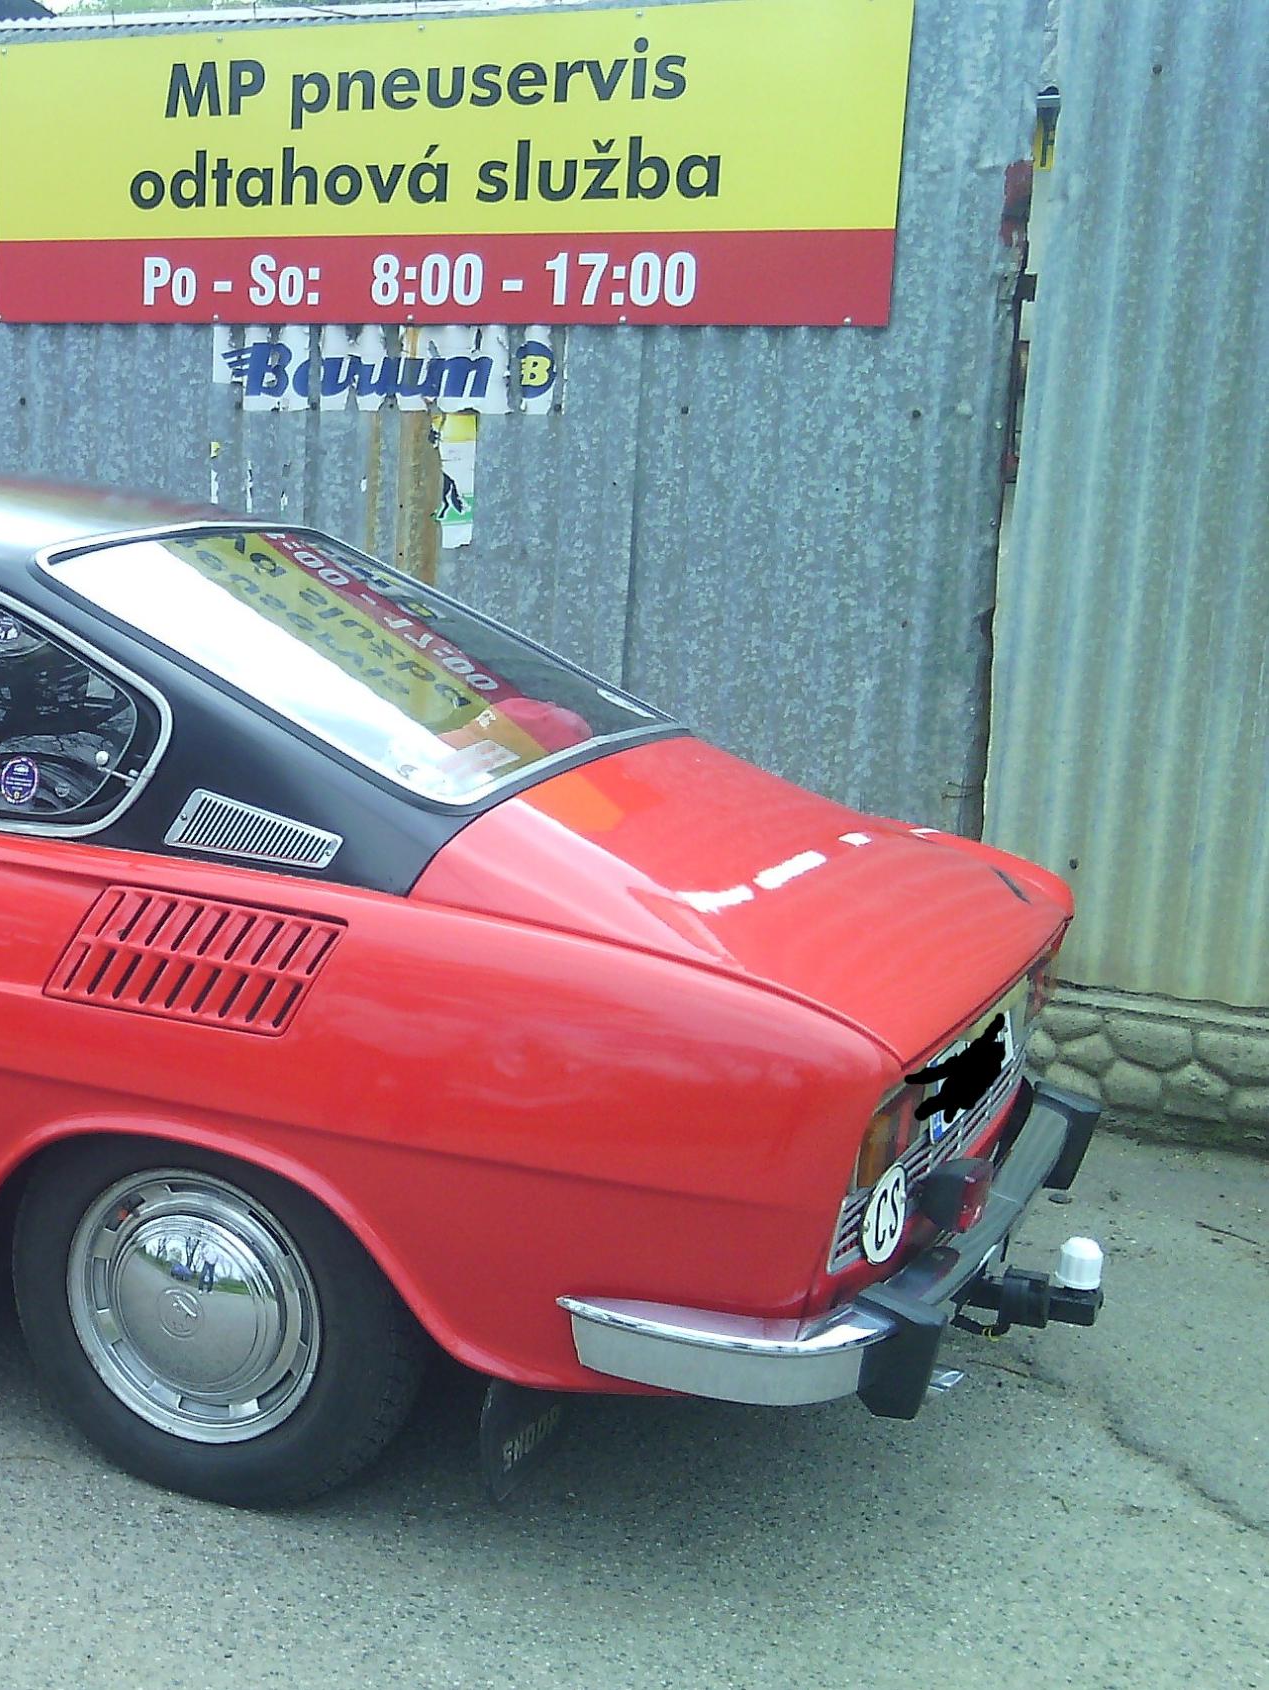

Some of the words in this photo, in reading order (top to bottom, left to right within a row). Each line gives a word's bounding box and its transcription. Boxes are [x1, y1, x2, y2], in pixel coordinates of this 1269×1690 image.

[165, 60, 266, 119] MP
[292, 37, 688, 129] pneuservis
[130, 145, 449, 212] odtahová
[476, 136, 721, 203] služba
[142, 257, 197, 307] Po
[214, 280, 231, 291] -
[249, 255, 320, 305] So:
[371, 253, 483, 305] 8:00
[502, 280, 523, 291] -
[544, 251, 698, 308] 17:00
[874, 1179, 902, 1248] CS
